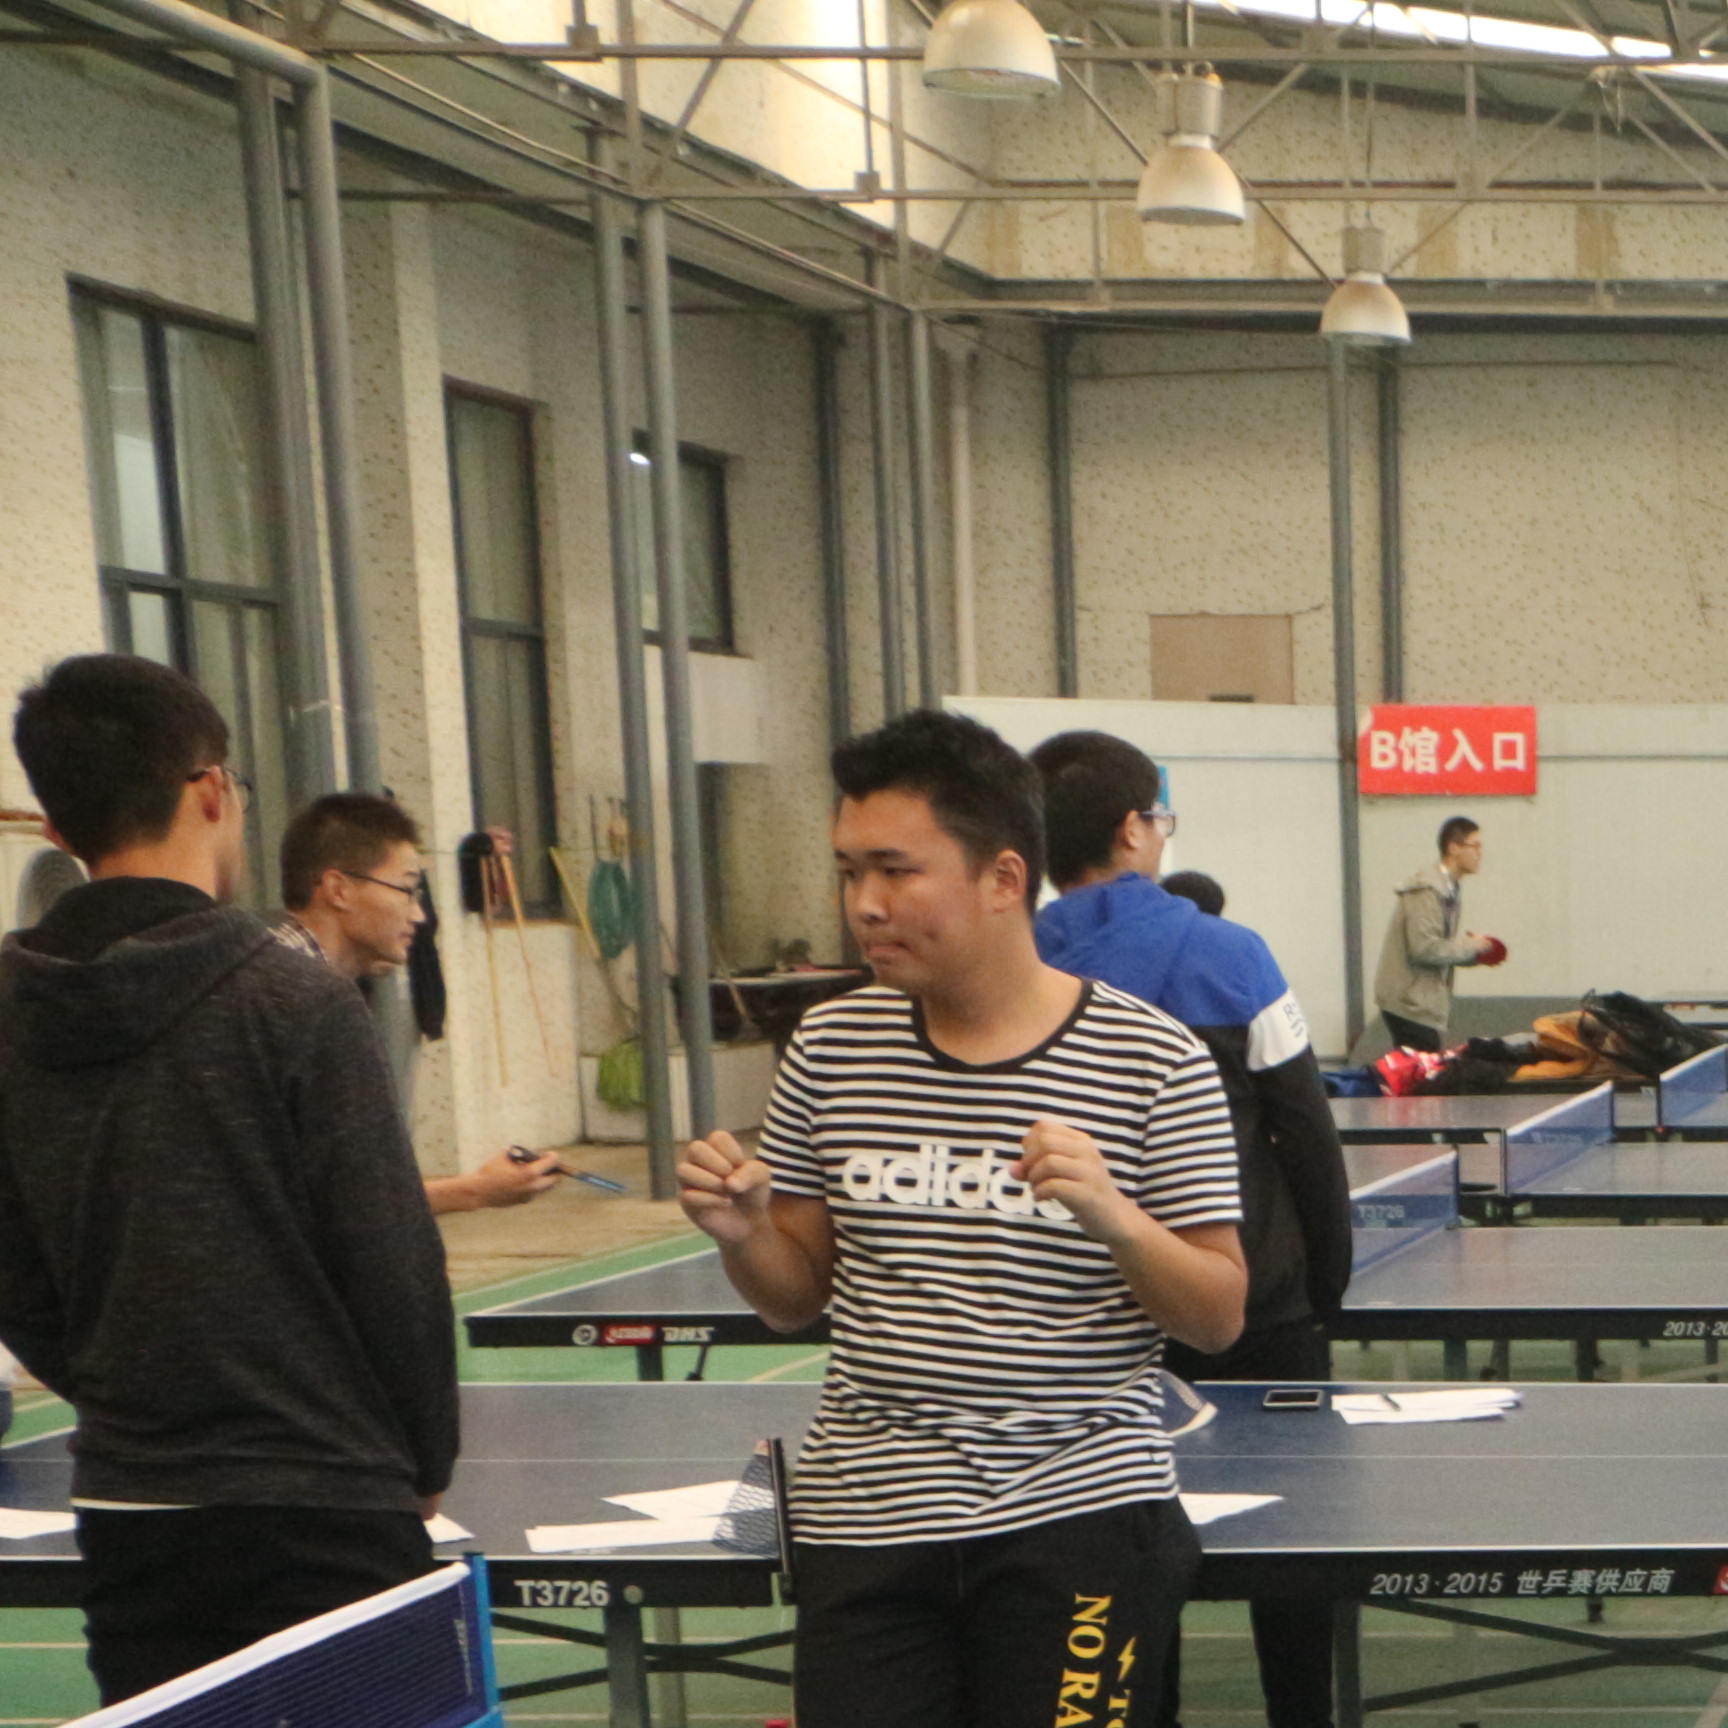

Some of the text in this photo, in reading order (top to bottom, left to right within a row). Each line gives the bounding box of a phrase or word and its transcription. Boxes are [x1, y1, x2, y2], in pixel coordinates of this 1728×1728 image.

[1370, 727, 1526, 774] B馆入口
[513, 1579, 611, 1607] T3726
[1516, 1568, 1676, 1594] 世乒赛供应商
[1066, 1592, 1113, 1660] NO
